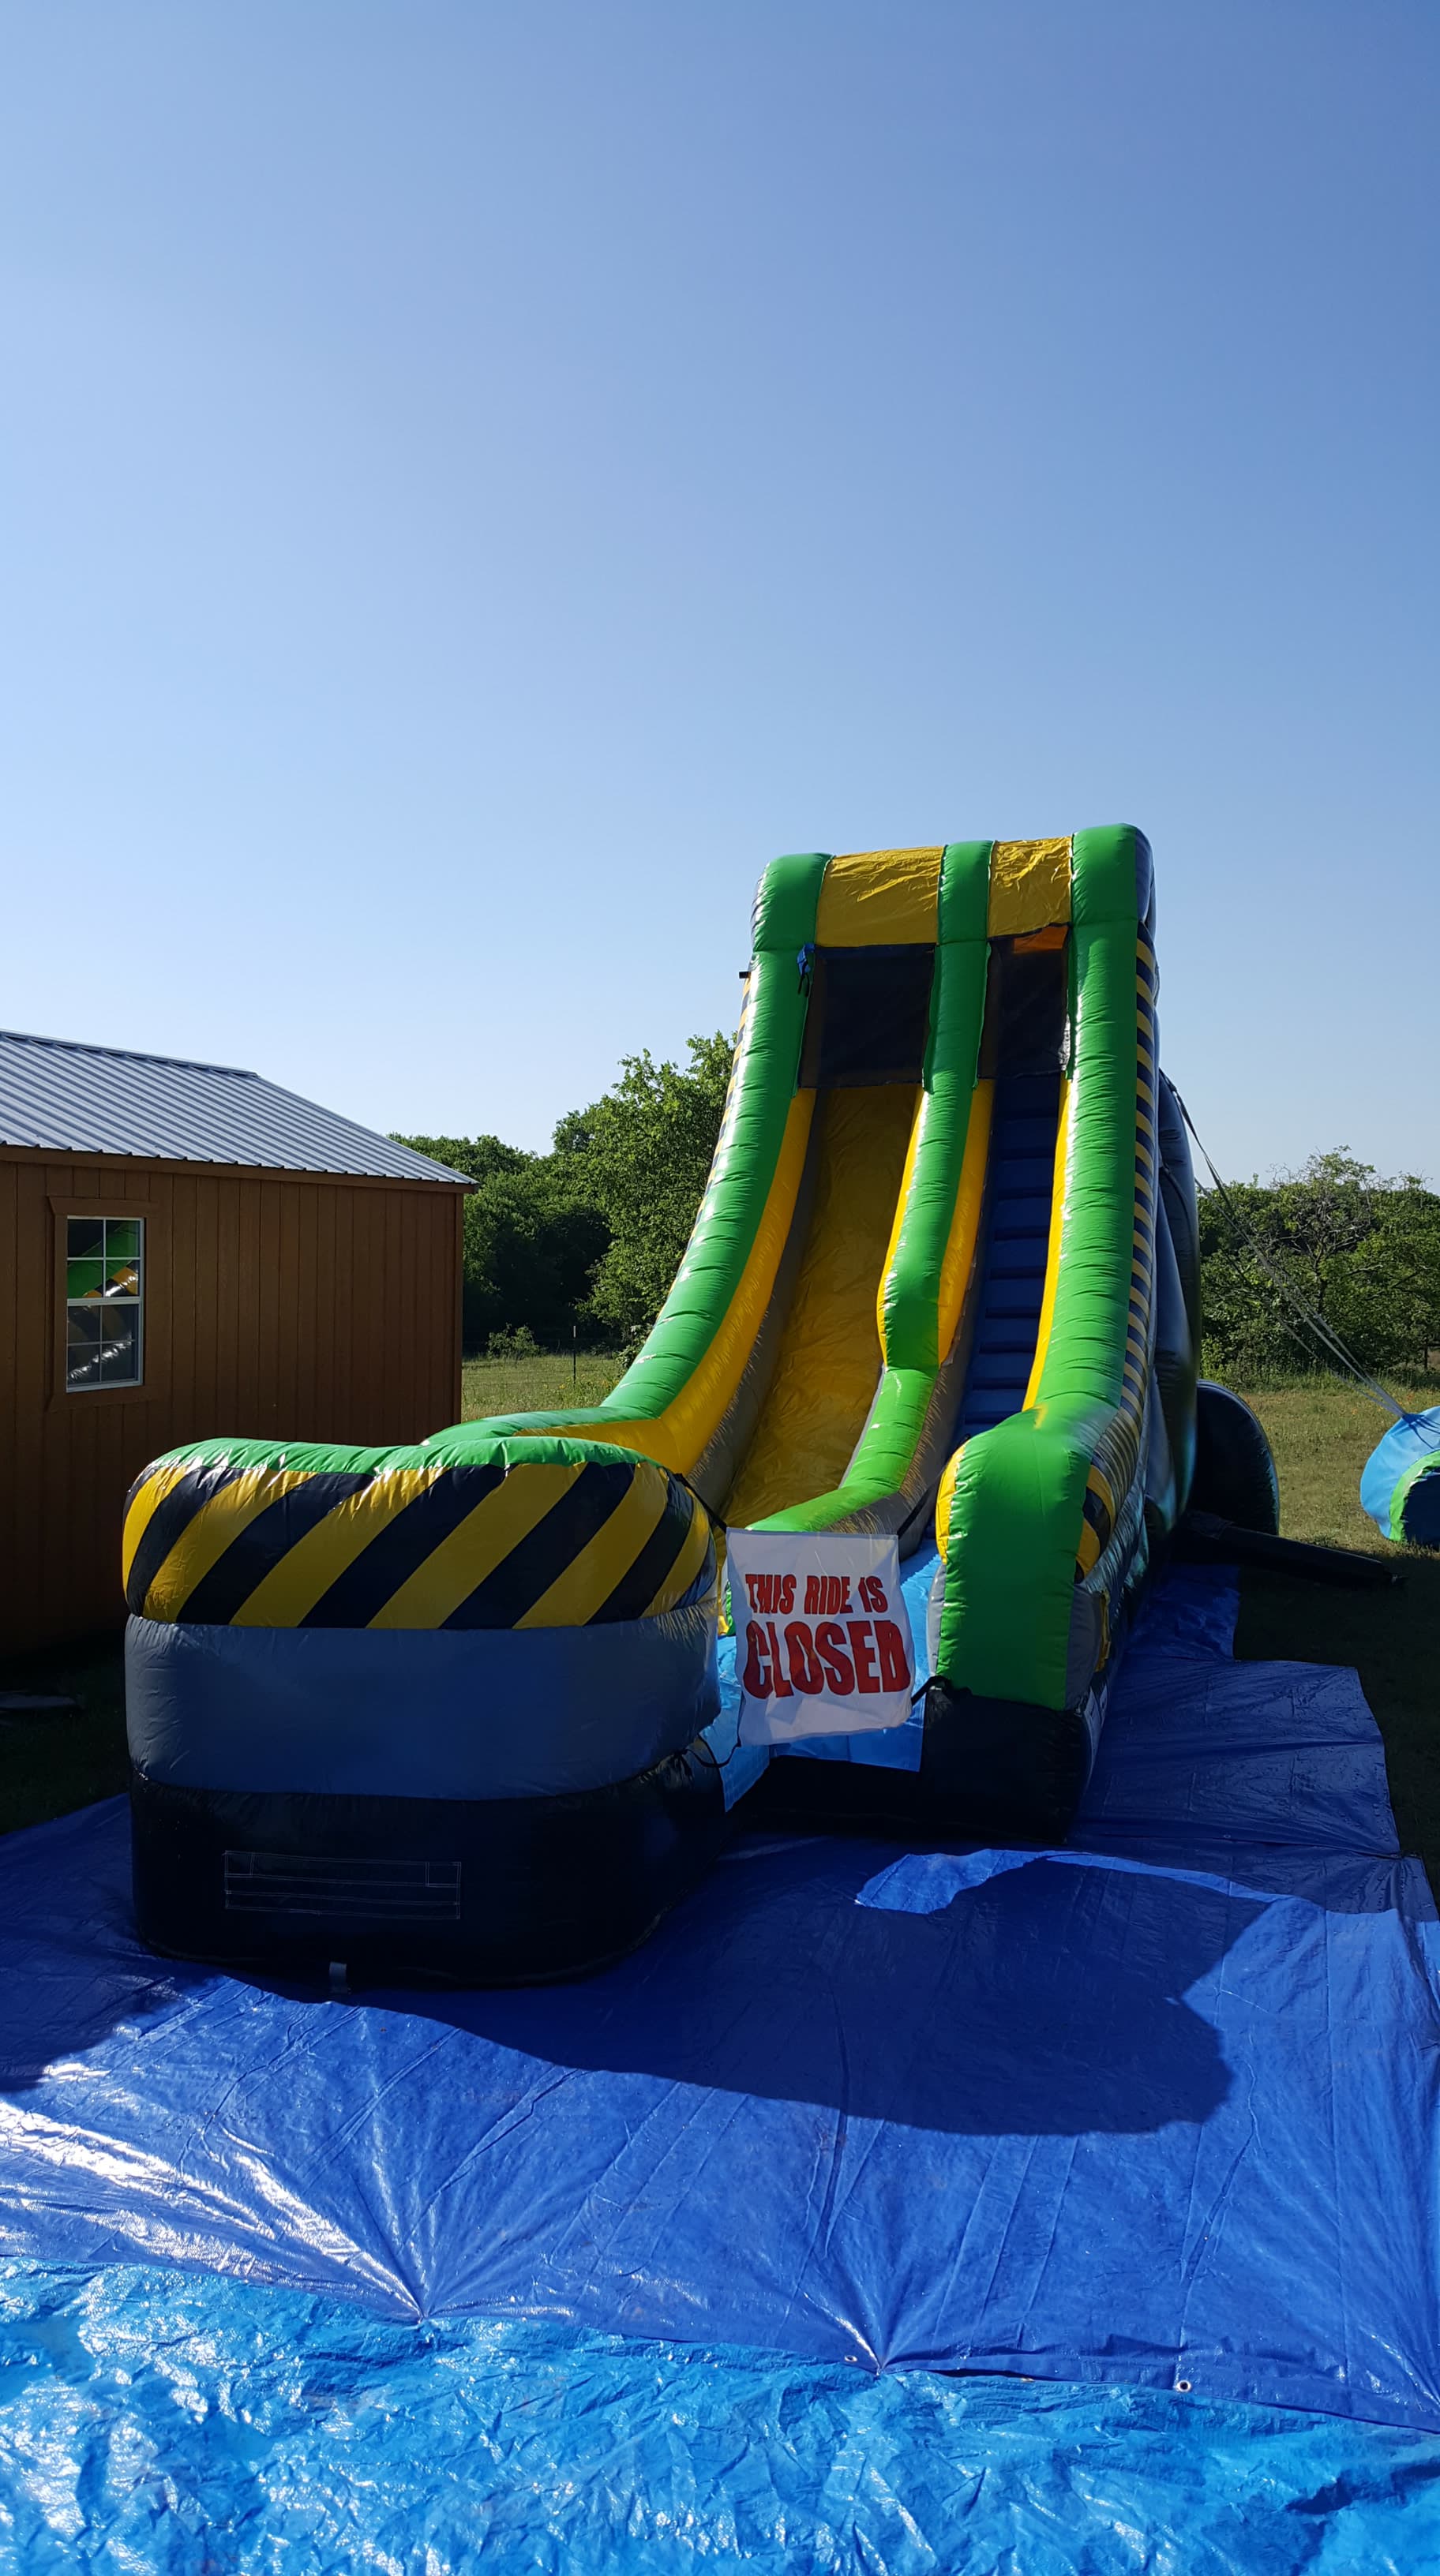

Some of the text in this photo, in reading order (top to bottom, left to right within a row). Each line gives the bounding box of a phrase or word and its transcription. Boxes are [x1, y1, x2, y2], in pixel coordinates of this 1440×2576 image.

[745, 1574, 888, 1615] THIS RIDE IS
[743, 1619, 911, 1699] CLOSED
